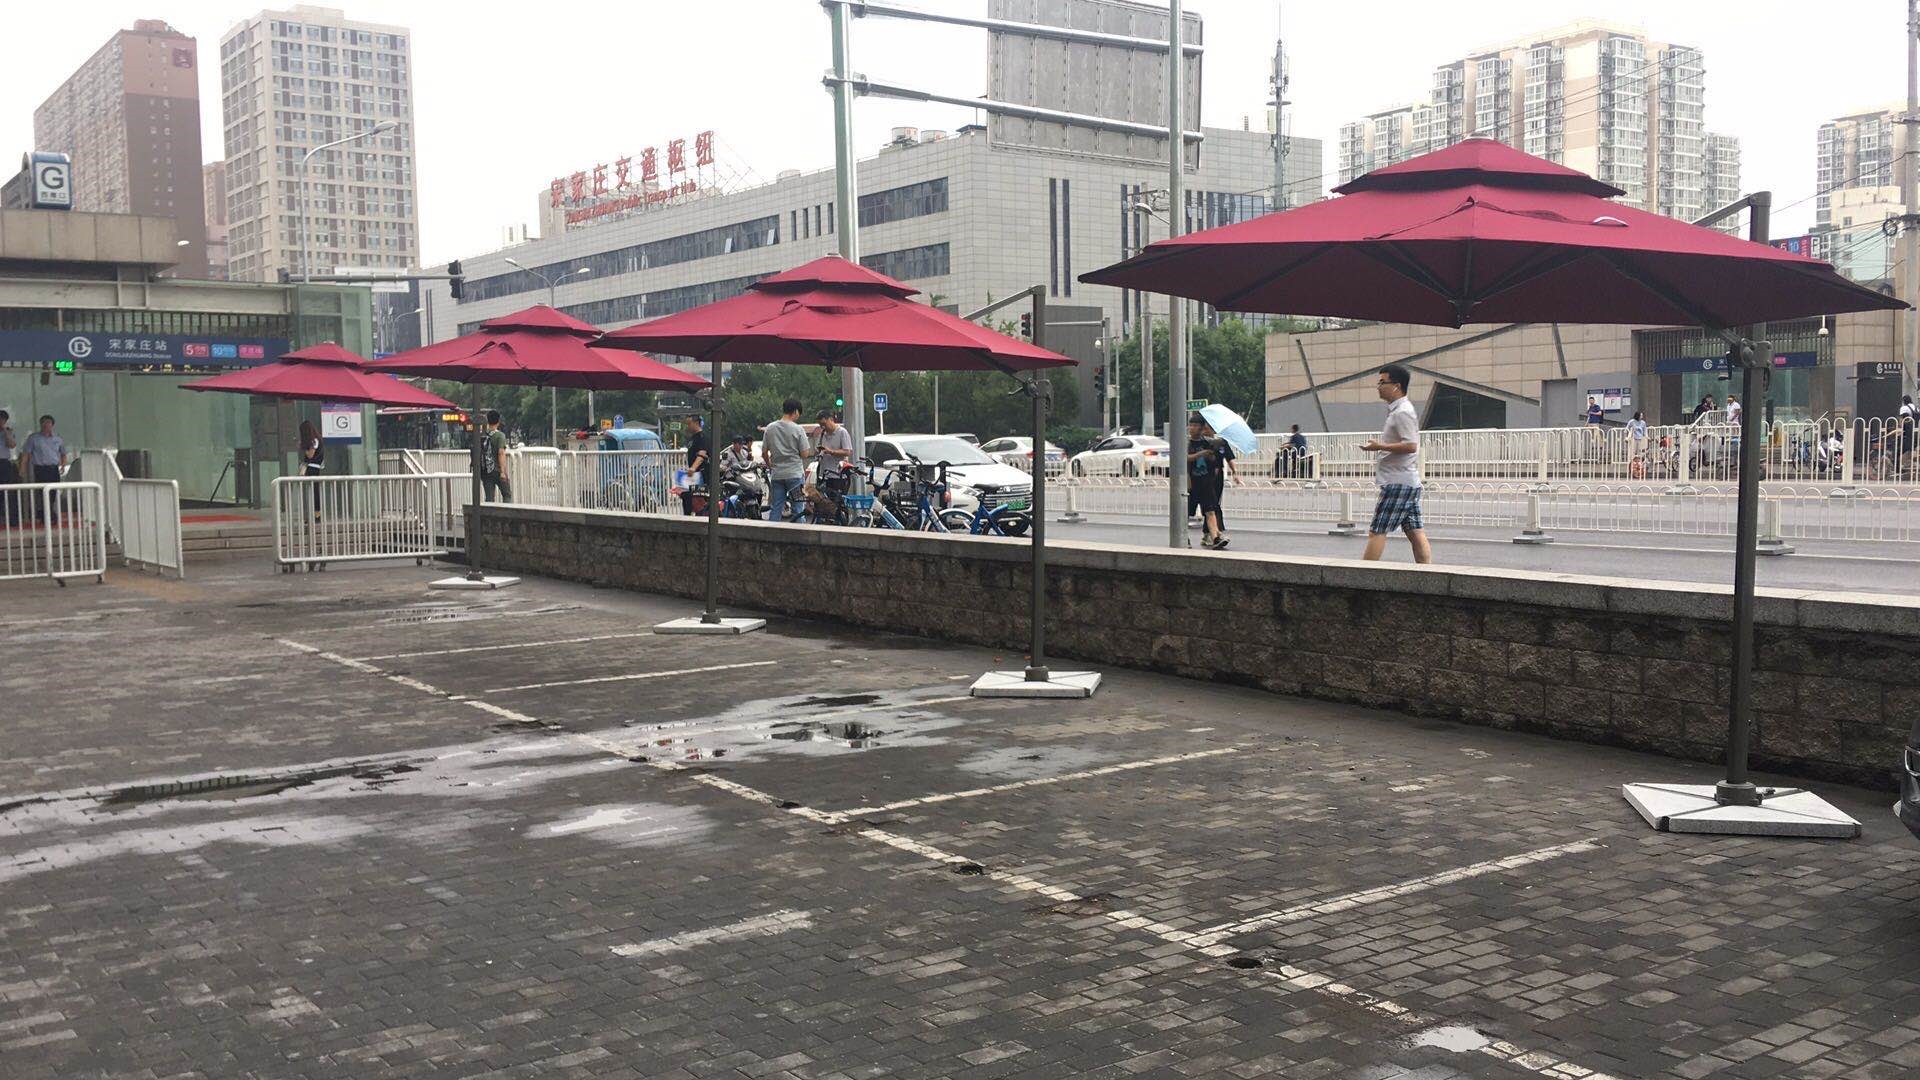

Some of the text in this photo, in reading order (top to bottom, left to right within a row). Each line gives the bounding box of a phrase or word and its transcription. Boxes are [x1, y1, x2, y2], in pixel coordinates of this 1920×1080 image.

[41, 166, 64, 190] G
[551, 130, 715, 208] 宋家庄交通枢纽
[108, 339, 168, 351] 宋家庄站
[336, 416, 349, 429] G
